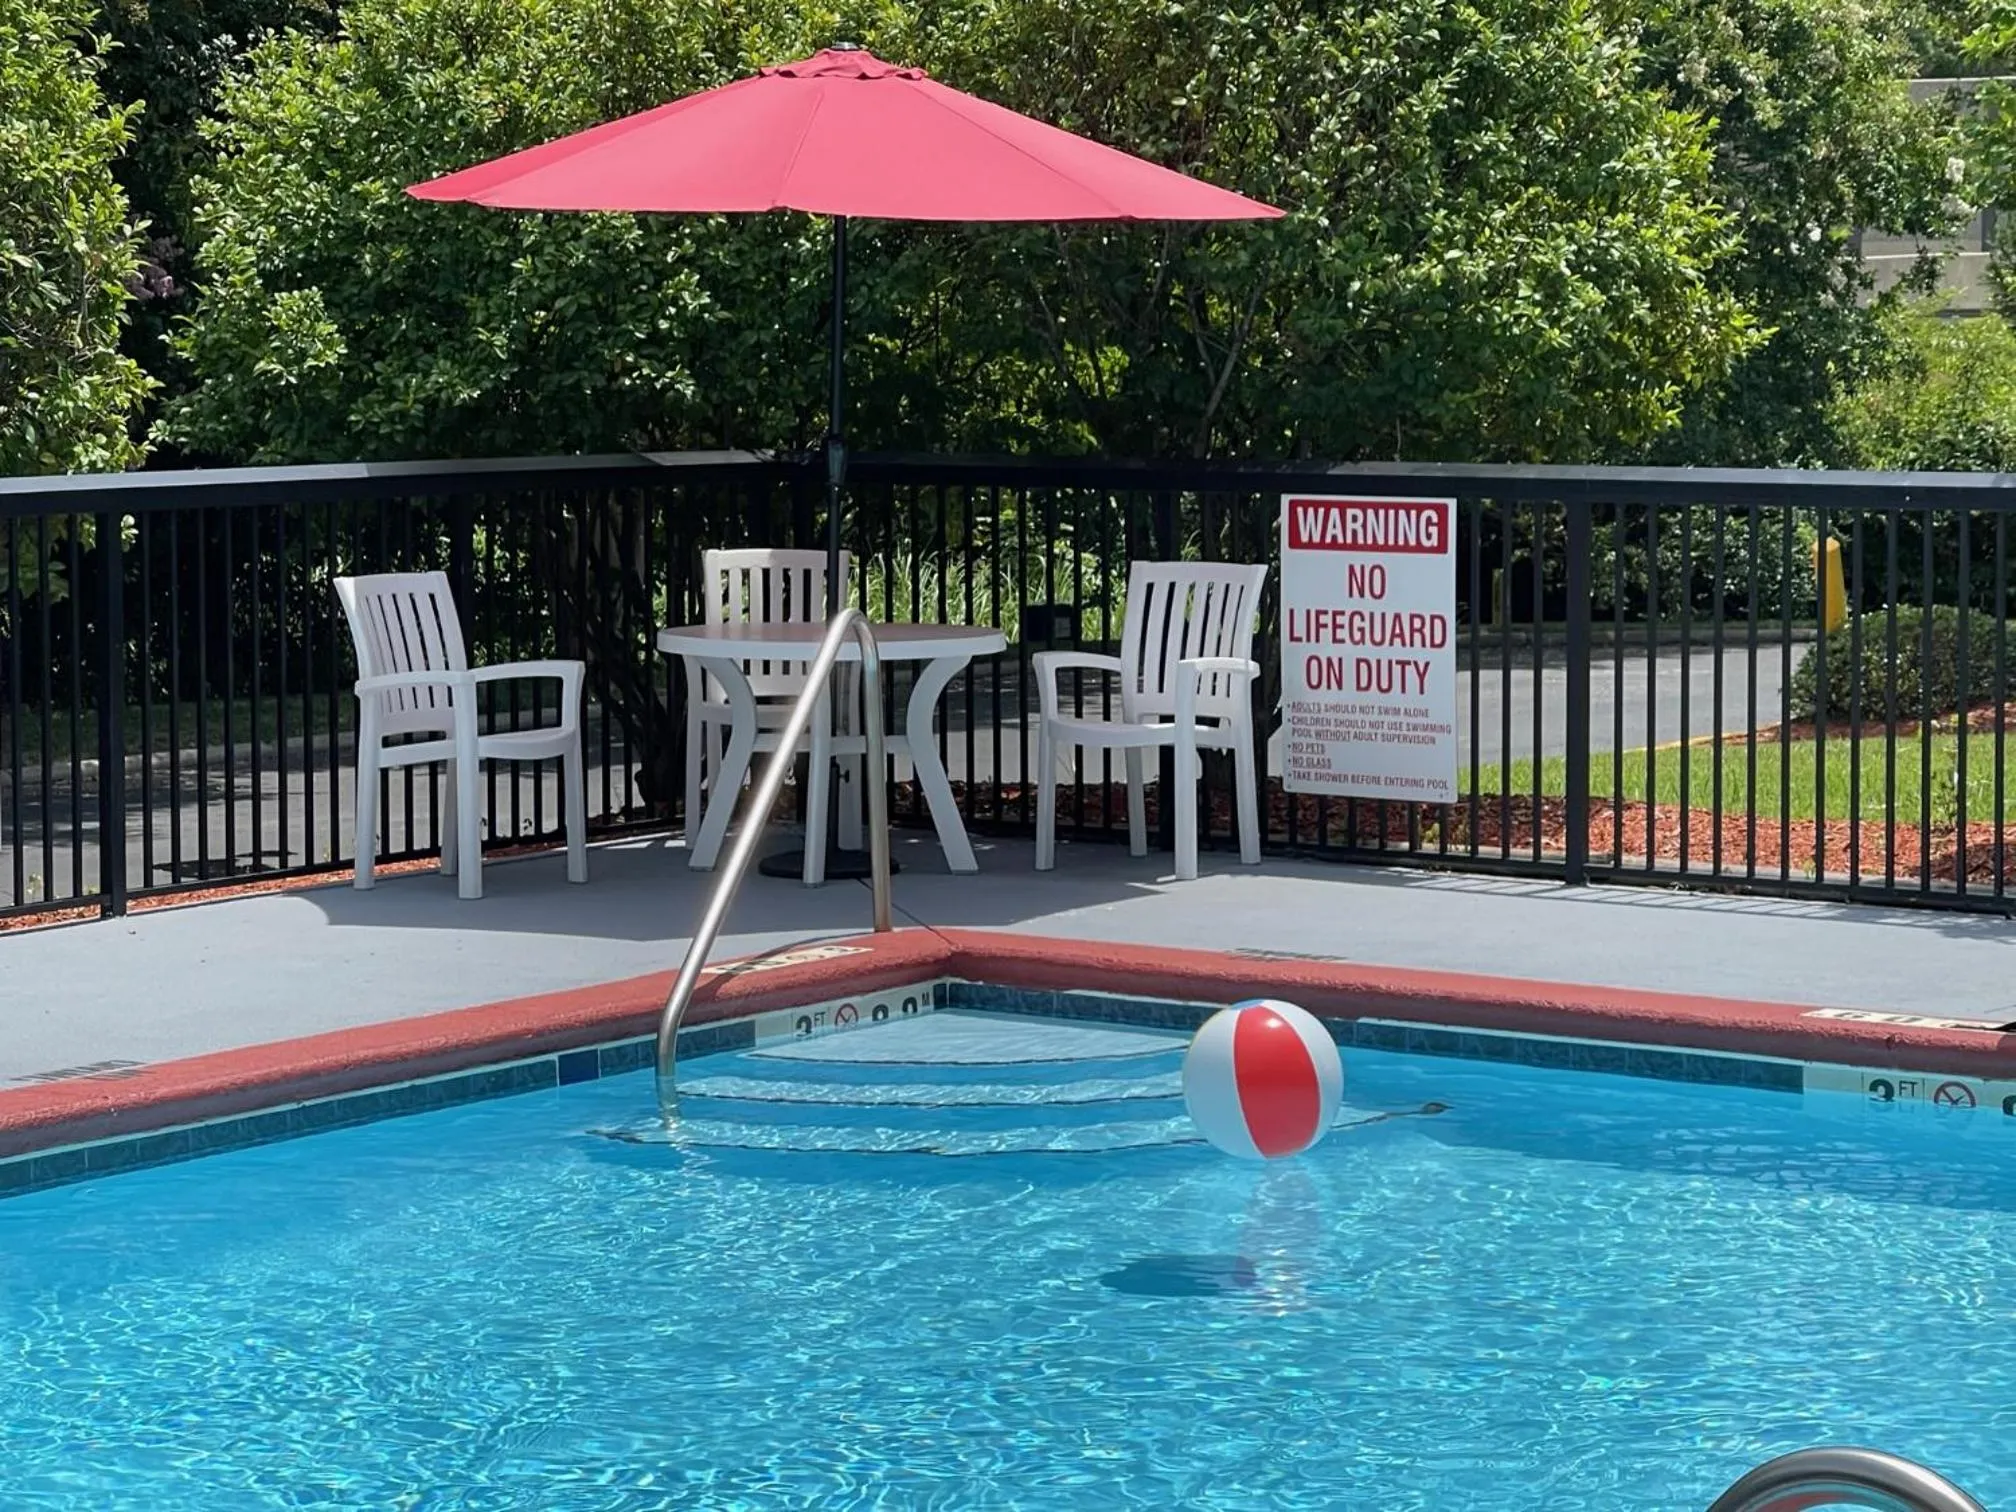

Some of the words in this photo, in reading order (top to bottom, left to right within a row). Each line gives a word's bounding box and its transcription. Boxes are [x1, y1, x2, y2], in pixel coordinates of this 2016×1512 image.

[1296, 506, 1439, 547] WARNING
[1348, 564, 1386, 600] NO
[1289, 608, 1447, 649] LIFEGUARD
[1305, 655, 1343, 690] ON
[1356, 658, 1430, 695] DUTY
[1291, 701, 1321, 714] ADULTS
[1324, 703, 1357, 714] SHOULD
[1359, 704, 1375, 715] NOT
[1378, 706, 1401, 716] SWIM
[1403, 707, 1429, 718] ALONE
[1291, 716, 1332, 727] CHILDREN
[1334, 718, 1366, 729] SHOULD
[1368, 720, 1385, 730] NOT
[1387, 721, 1404, 731] USE
[1406, 722, 1451, 734] SWIMMING
[1291, 727, 1312, 738] POOL
[1315, 729, 1351, 742] WITHOUT
[1353, 731, 1378, 743] ADULT
[1381, 733, 1436, 745] SUPERVISION
[1292, 743, 1304, 754] NO
[1306, 743, 1325, 755] PETS
[1292, 756, 1304, 768] NO
[1306, 757, 1332, 769] GLASS
[1292, 770, 1311, 781] TAKE
[1314, 772, 1349, 783] SHOWER
[1351, 774, 1382, 785] BEFORE
[1384, 776, 1424, 788] ENTERING
[1427, 778, 1449, 790] POOL
[1899, 1080, 1918, 1097] FT
